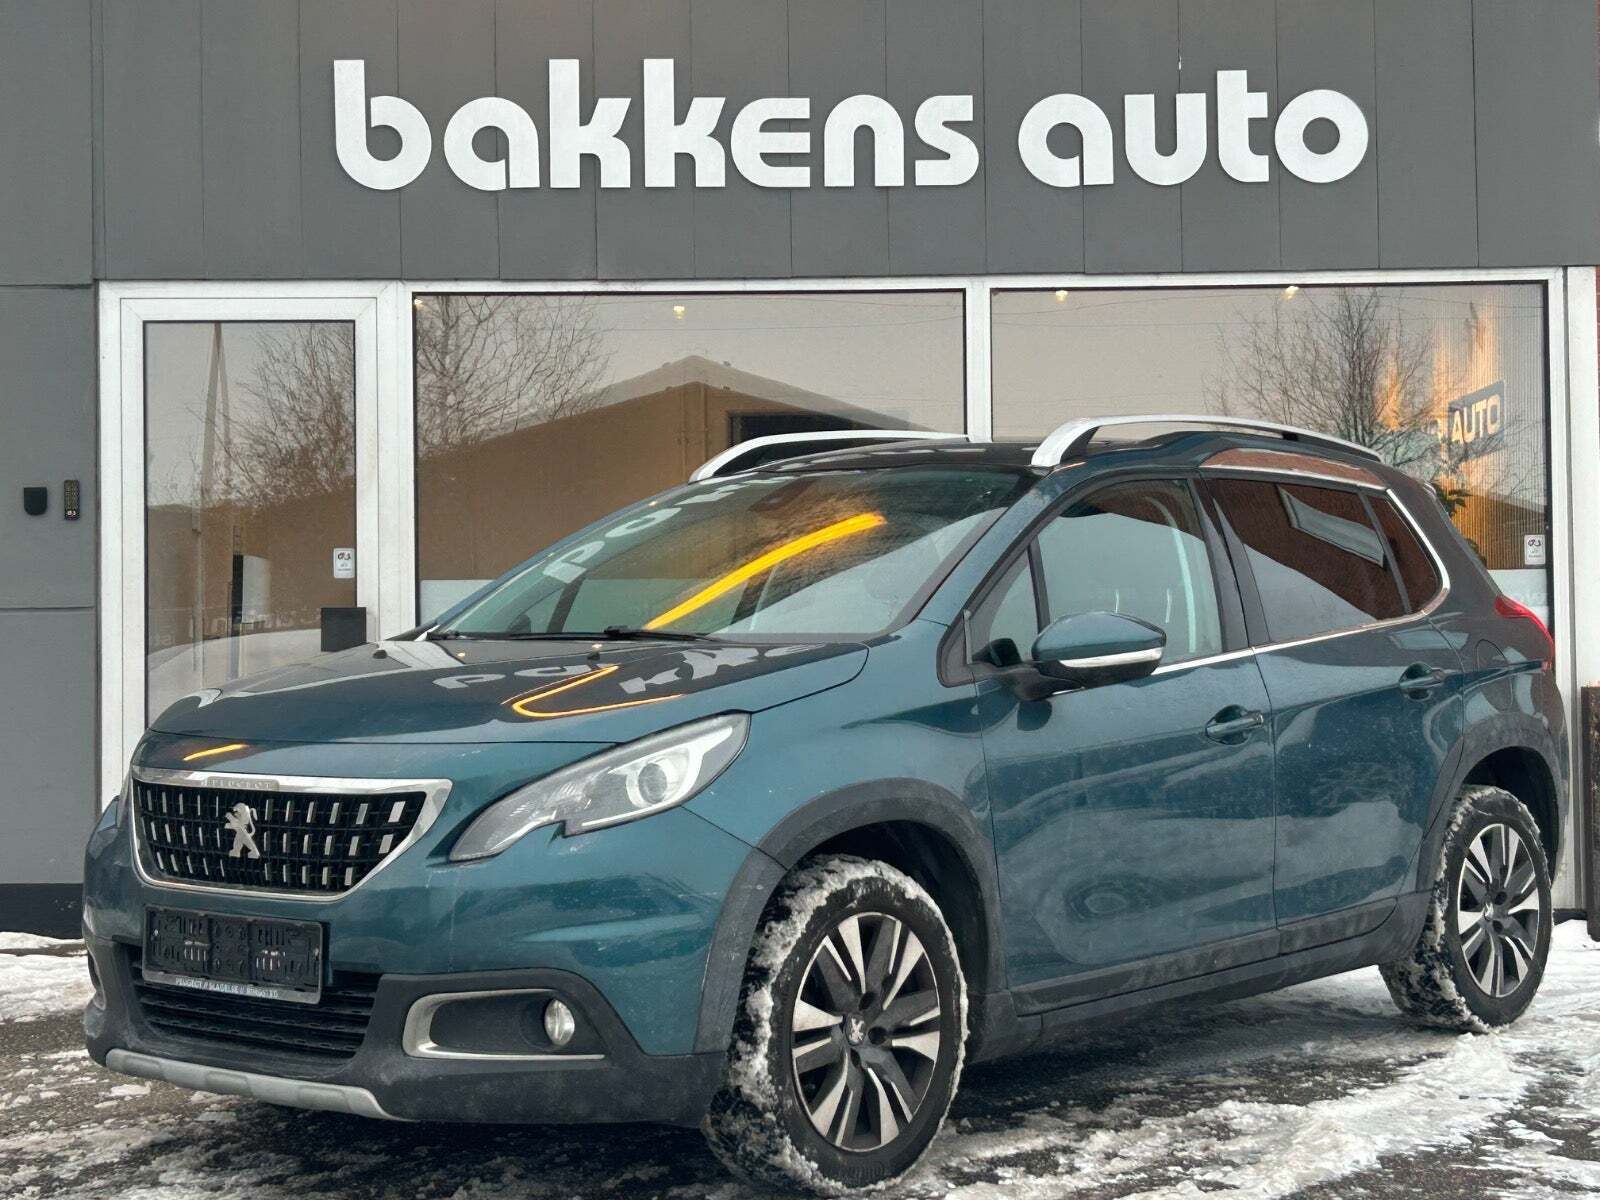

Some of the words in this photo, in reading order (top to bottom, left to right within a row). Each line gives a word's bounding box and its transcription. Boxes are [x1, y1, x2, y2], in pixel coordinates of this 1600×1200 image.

[333, 58, 979, 191] bakkens
[1018, 69, 1369, 188] auto
[1451, 394, 1500, 444] AUTO
